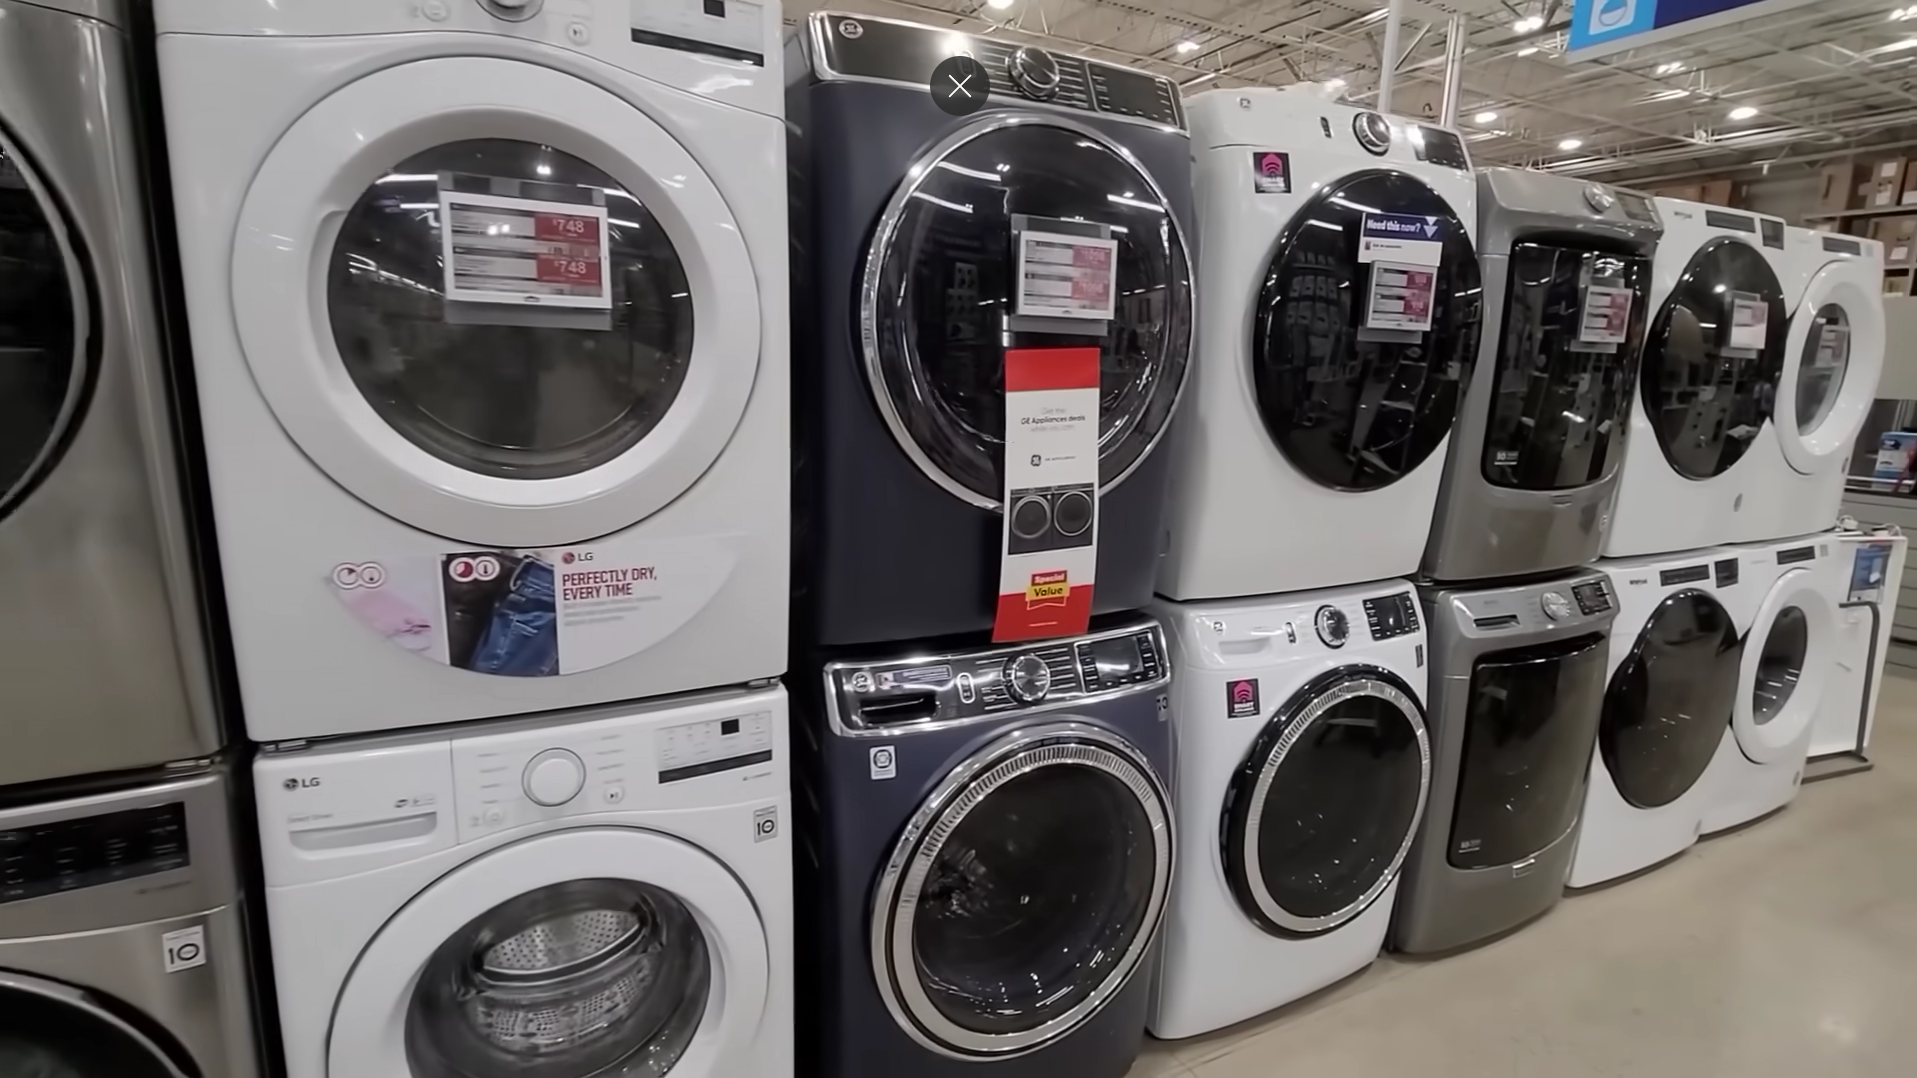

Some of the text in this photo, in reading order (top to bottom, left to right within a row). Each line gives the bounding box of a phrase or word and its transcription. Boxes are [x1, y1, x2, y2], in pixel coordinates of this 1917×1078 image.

[578, 552, 593, 561] LG
[562, 566, 657, 586] PERFECTLY DRY,
[563, 583, 633, 601] EVERY TIME
[1034, 586, 1063, 597] Value
[301, 776, 321, 788] LG
[168, 942, 200, 965] 10
